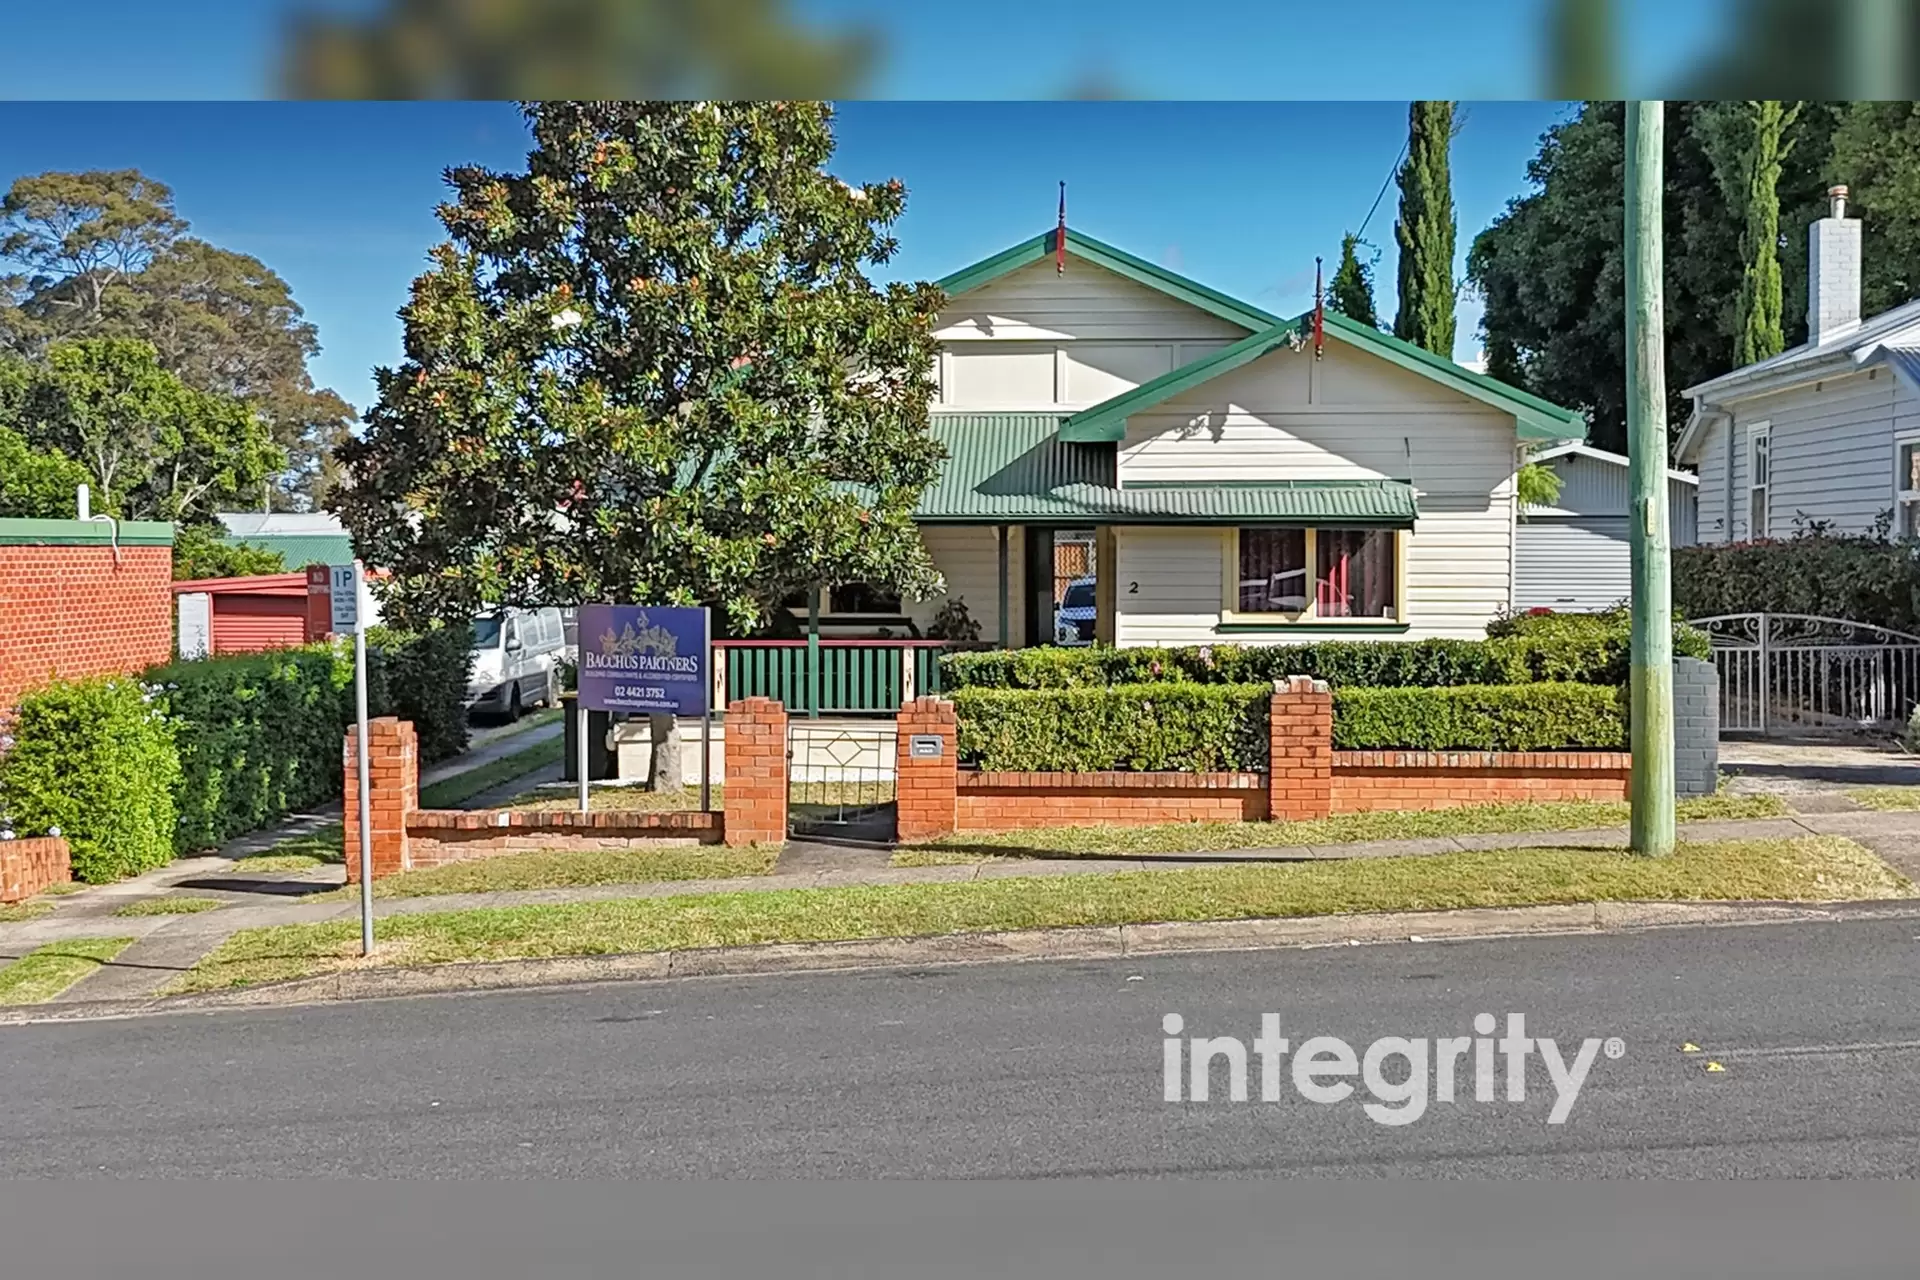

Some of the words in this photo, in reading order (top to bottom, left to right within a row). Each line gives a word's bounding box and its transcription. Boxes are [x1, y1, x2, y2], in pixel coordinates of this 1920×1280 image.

[1128, 581, 1139, 594] 2
[586, 652, 638, 669] BACCHUS
[640, 656, 698, 672] PARTNERS
[614, 686, 625, 697] 02
[626, 687, 645, 697] 4421
[646, 687, 665, 698] 3752
